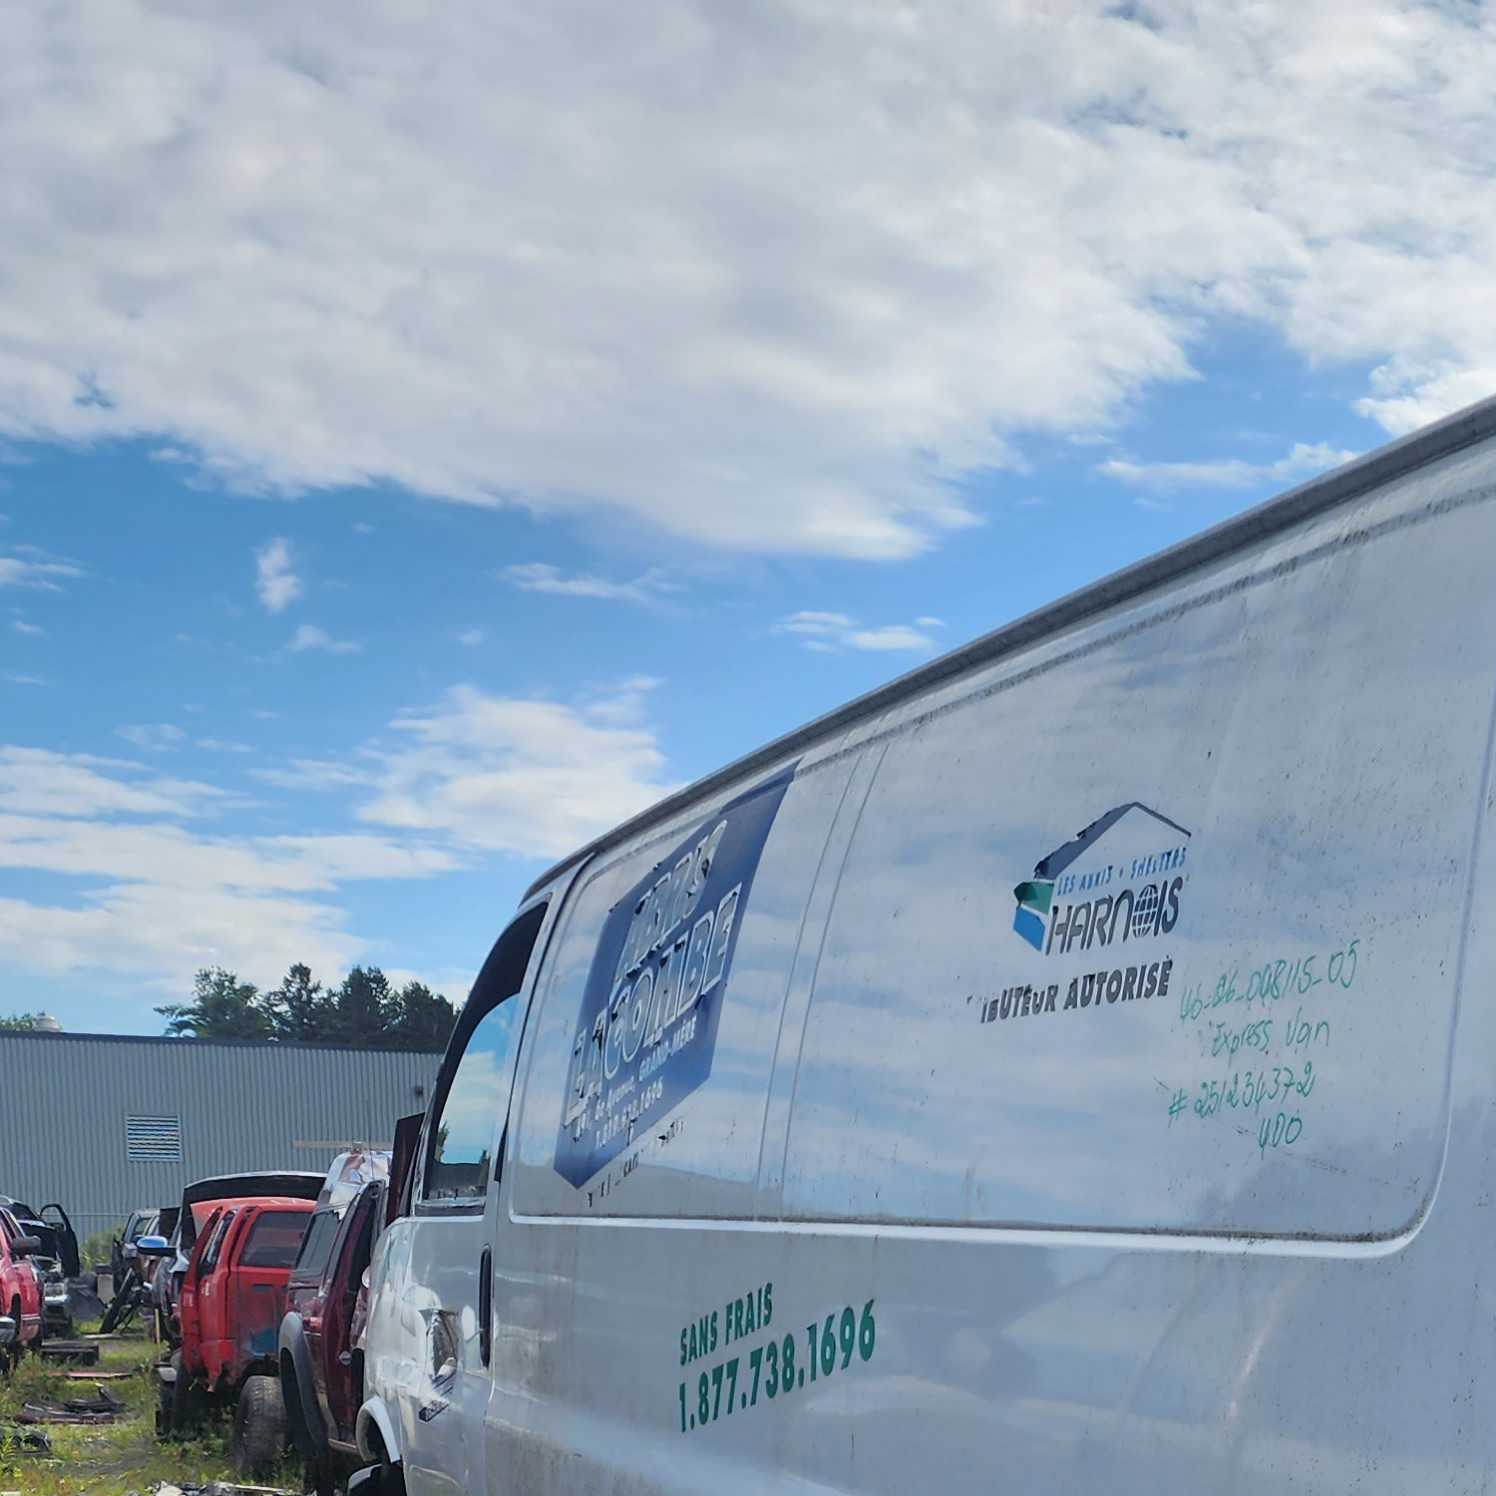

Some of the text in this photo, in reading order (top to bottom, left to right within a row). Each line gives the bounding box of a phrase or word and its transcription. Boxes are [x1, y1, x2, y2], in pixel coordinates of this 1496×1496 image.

[679, 1299, 876, 1433] 1.877.738.1696
[680, 1282, 773, 1366] SANS FRAIS
